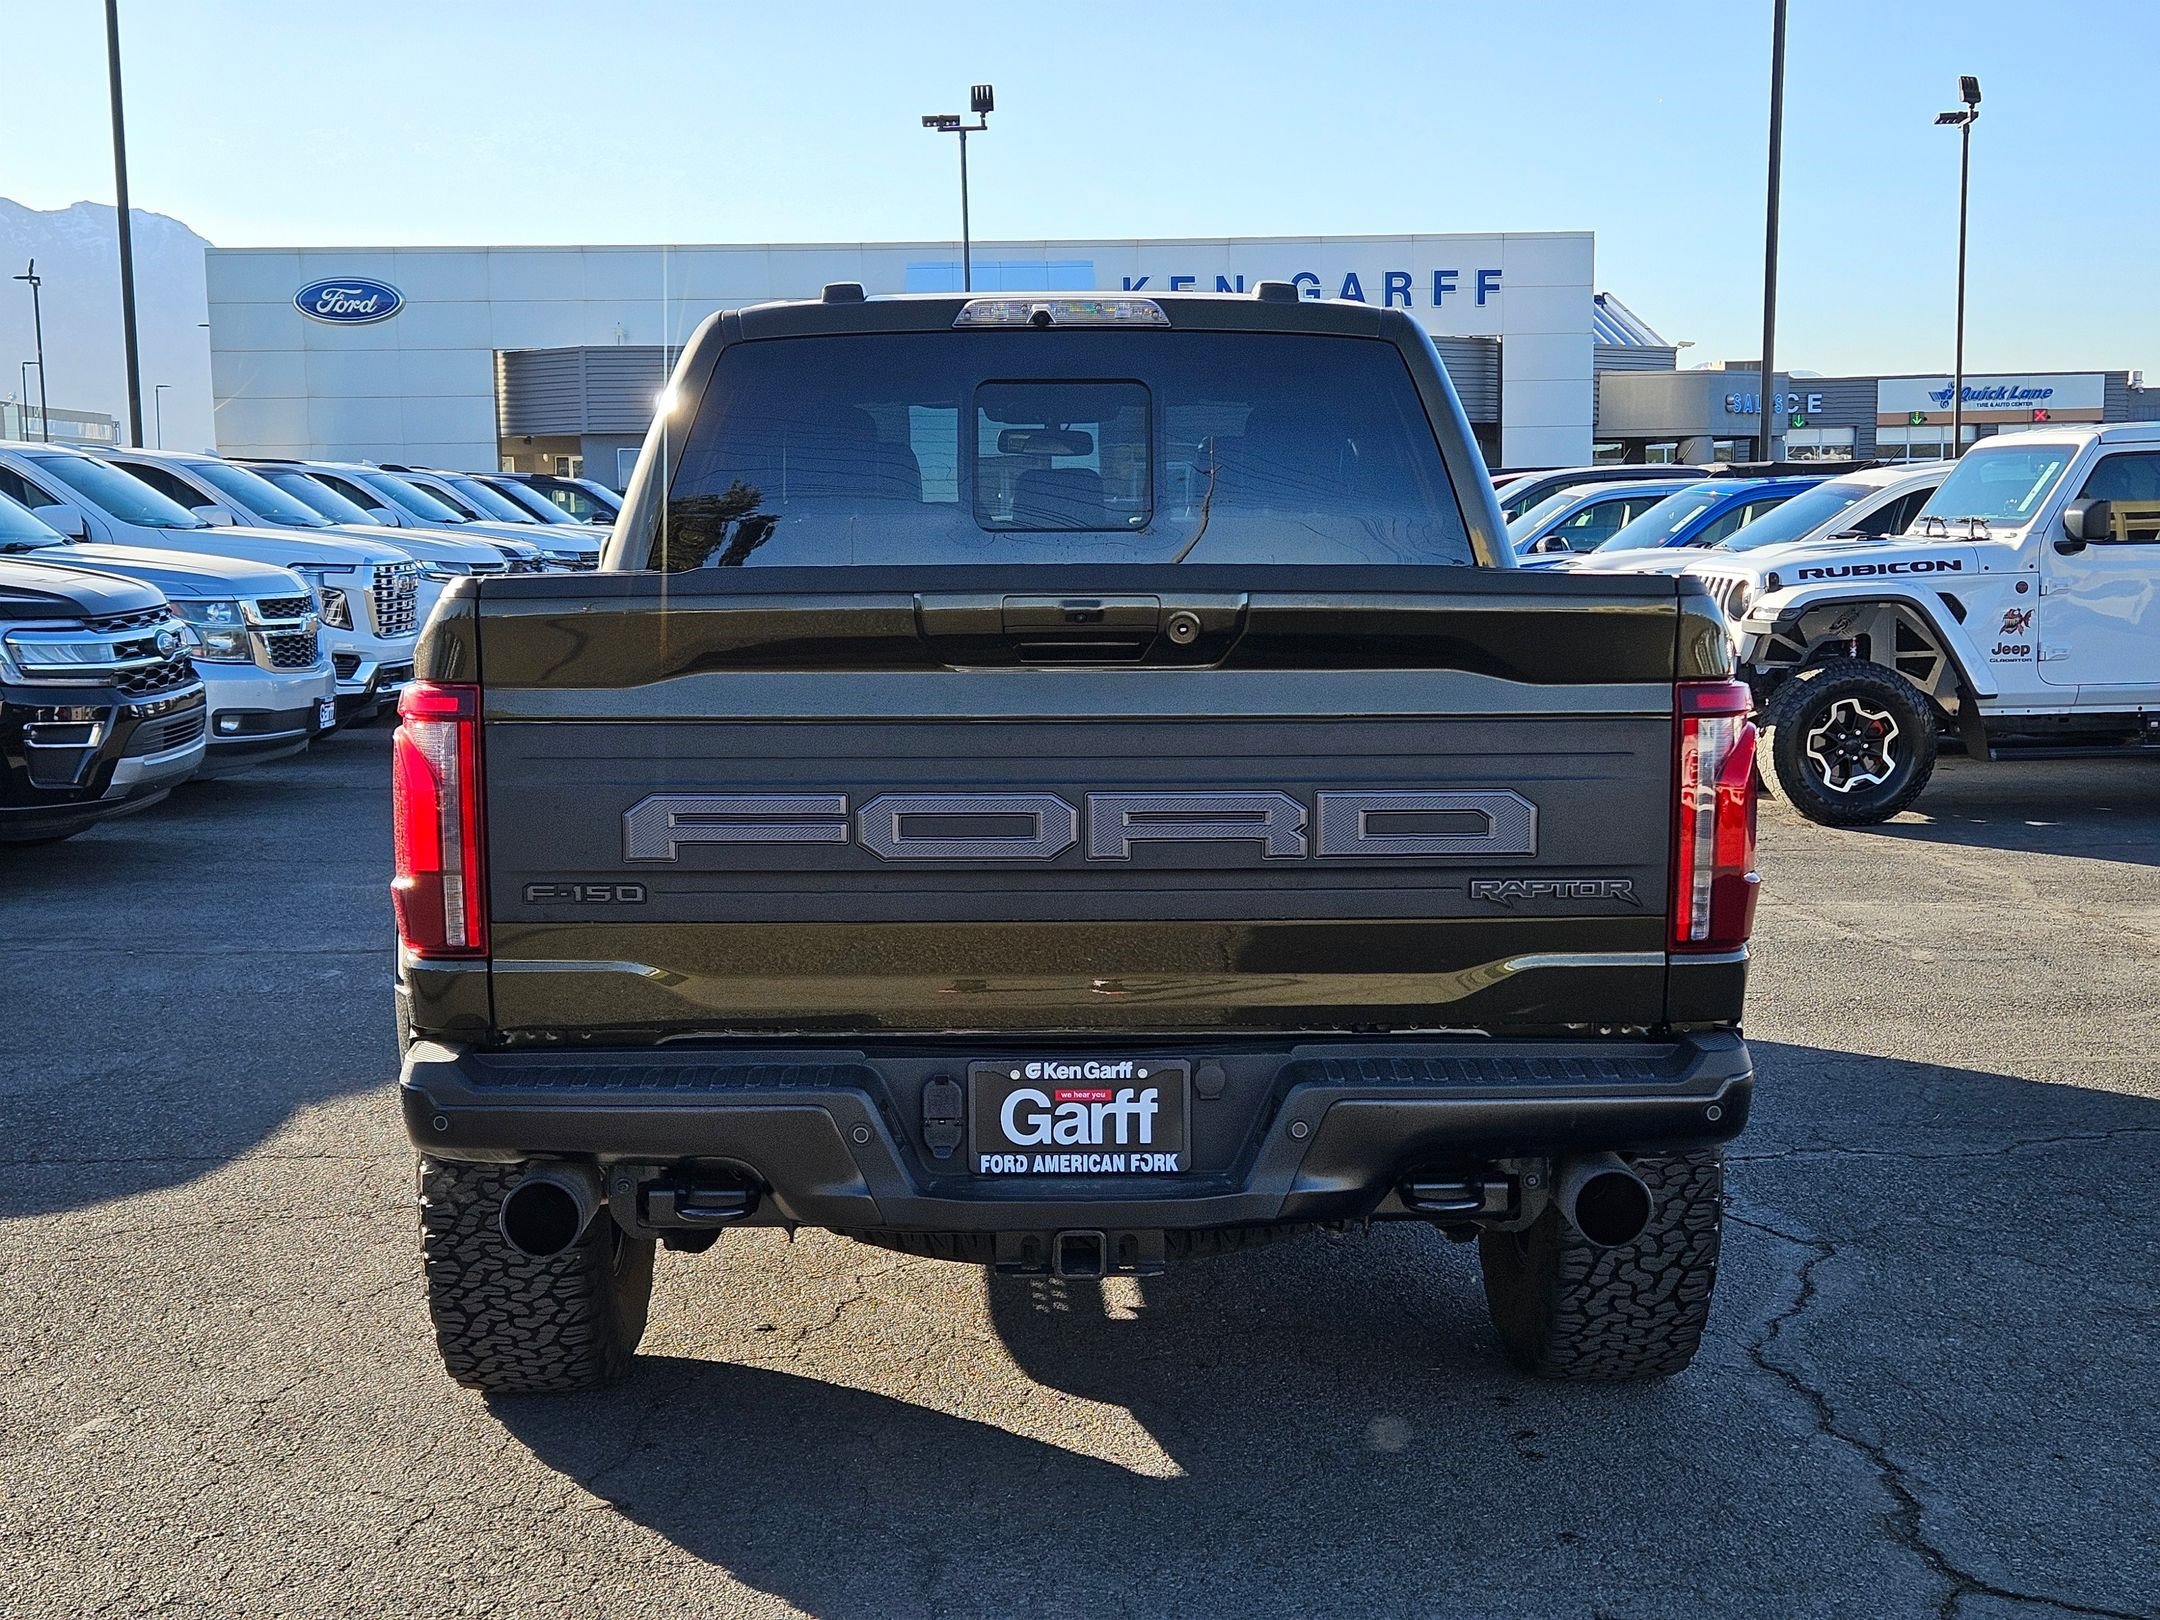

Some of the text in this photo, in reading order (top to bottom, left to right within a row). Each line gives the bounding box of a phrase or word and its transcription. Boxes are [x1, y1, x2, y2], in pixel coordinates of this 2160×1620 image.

[1290, 268, 1503, 308] GARFF
[316, 288, 378, 313] Ford
[1733, 392, 1783, 414] SALS
[1961, 386, 2053, 401] Quick Lane
[1798, 560, 1962, 580] RUBICON
[1991, 642, 2031, 657] Jeep
[623, 791, 1537, 861] FORD
[526, 885, 643, 902] F-150
[1471, 879, 1643, 909] RAPTOR
[1044, 1061, 1133, 1079] Ken Garff
[1074, 1090, 1090, 1098] hear
[1091, 1092, 1106, 1100] you
[1000, 1088, 1158, 1146] Garff
[981, 1153, 1179, 1173] FORD AMERICAN FORK
